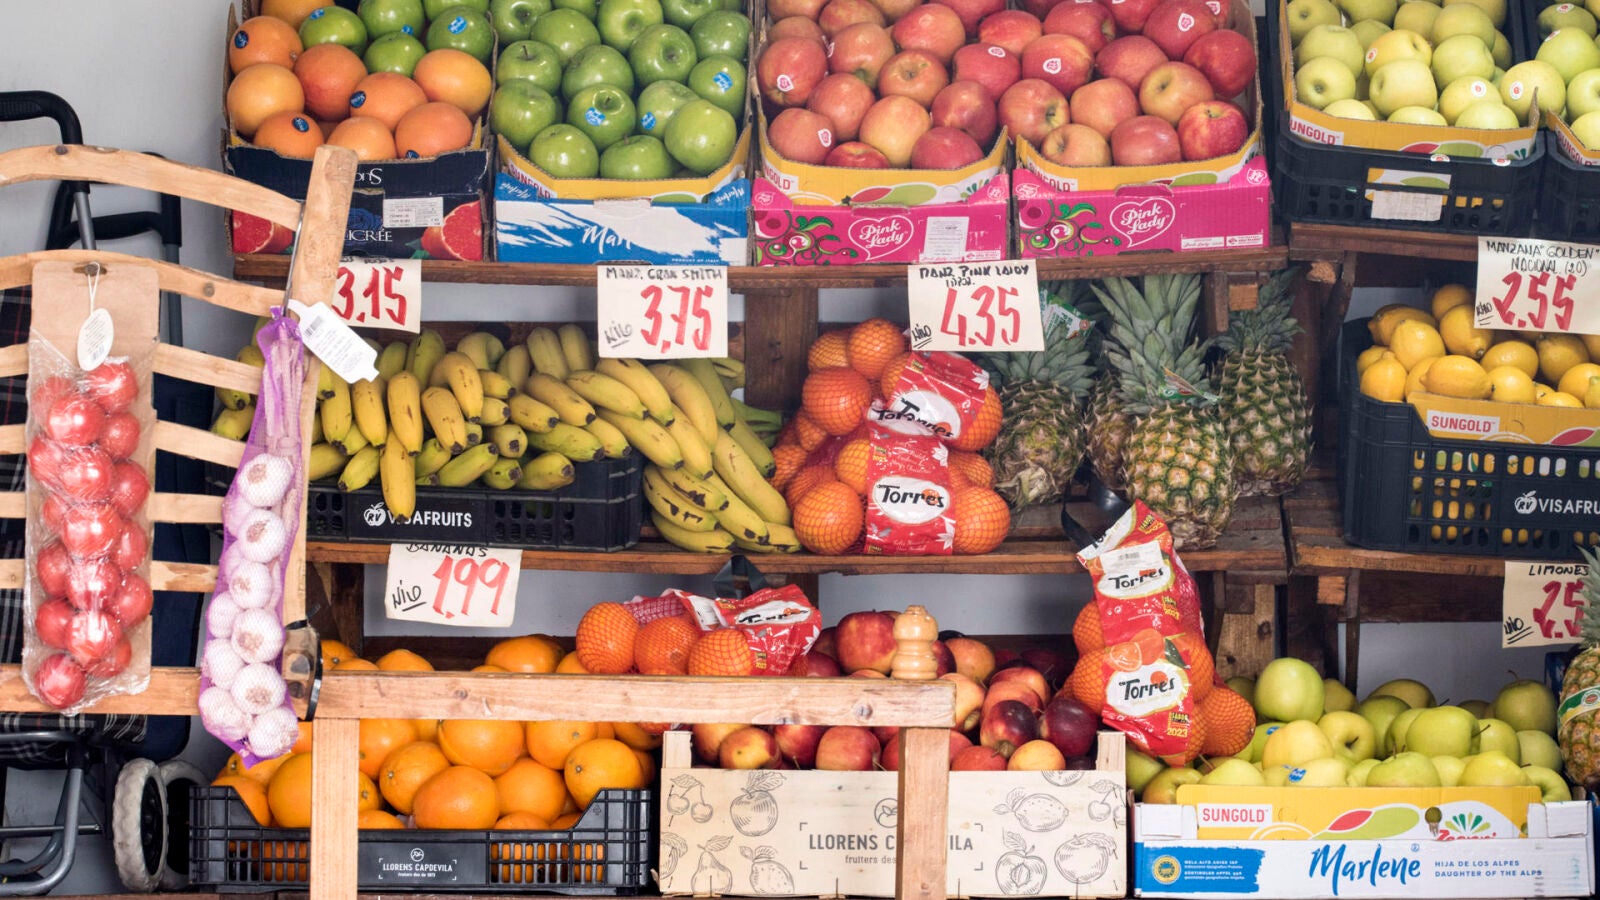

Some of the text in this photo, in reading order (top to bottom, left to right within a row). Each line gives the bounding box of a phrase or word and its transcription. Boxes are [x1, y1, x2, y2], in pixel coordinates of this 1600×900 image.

[1289, 119, 1336, 145] UNGOLD
[1120, 203, 1163, 226] Pink
[344, 227, 393, 242] ICRÉE
[859, 219, 901, 240] Pink
[1127, 215, 1167, 235] Lady
[865, 231, 905, 249] Lady
[1492, 271, 1577, 331] 2.55
[940, 285, 1021, 347] 4.35
[1431, 415, 1492, 433] SUNGOLD
[877, 484, 945, 508] Torres
[387, 510, 472, 528] VAFRUITS
[1108, 568, 1164, 589] Torres
[1528, 564, 1590, 576] LIMONES
[1533, 580, 1585, 638] 2.5
[1119, 677, 1175, 701] Torres
[1167, 727, 1188, 738] 2023
[1202, 808, 1265, 823] SUNGOLD
[809, 834, 878, 850] LLORENS
[382, 863, 453, 872] LLORENS CAPDEVILA
